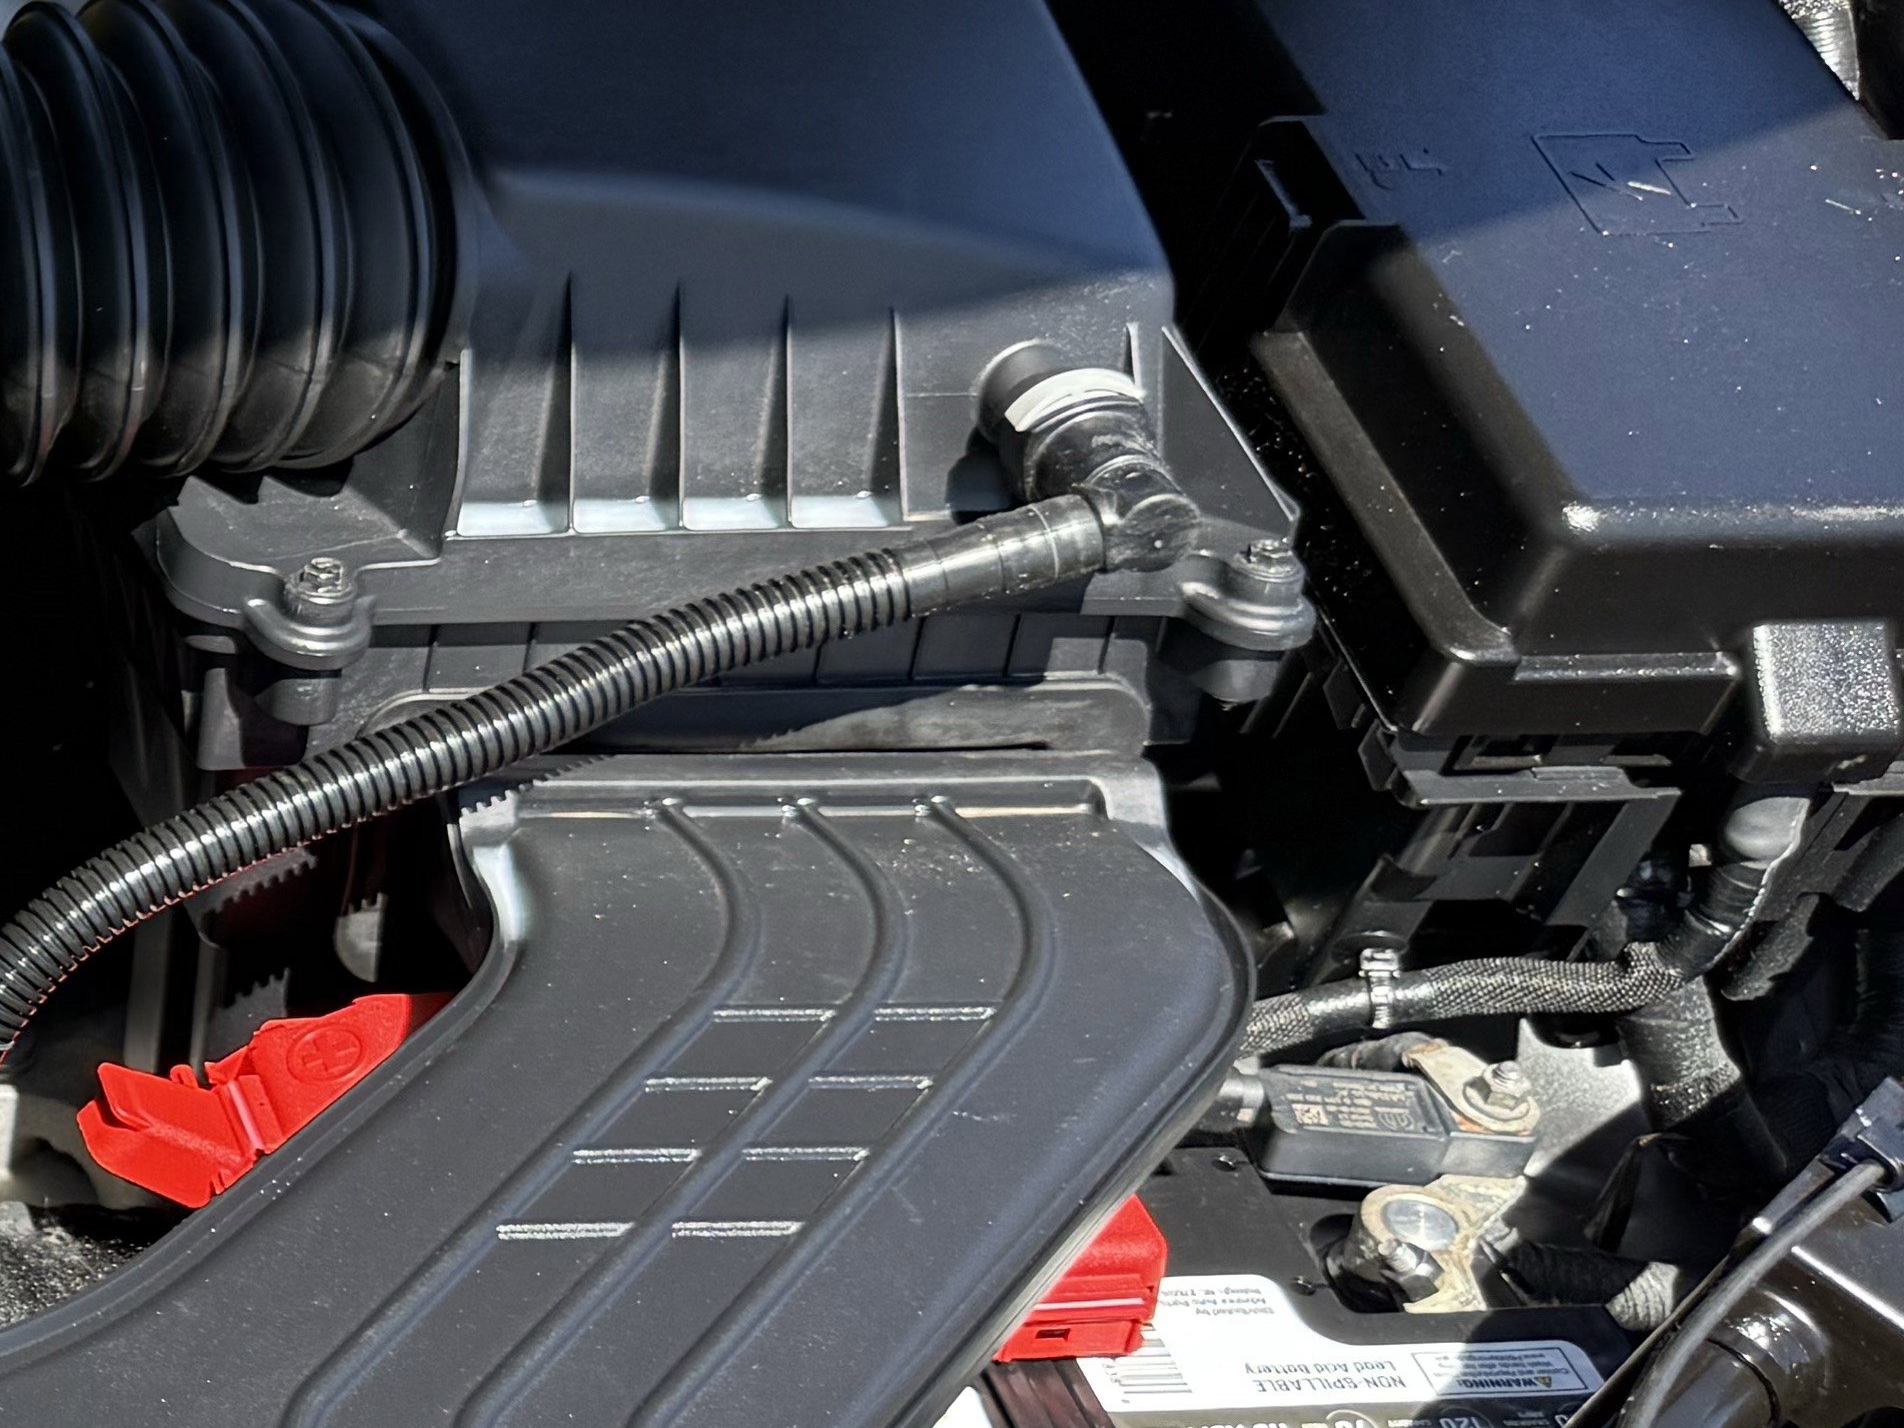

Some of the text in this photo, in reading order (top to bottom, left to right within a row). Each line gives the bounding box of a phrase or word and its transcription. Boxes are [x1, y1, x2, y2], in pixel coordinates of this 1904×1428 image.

[1244, 1360, 1397, 1376] Lead Acid Battery
[1251, 1375, 1405, 1393] NON-SPILLABLE
